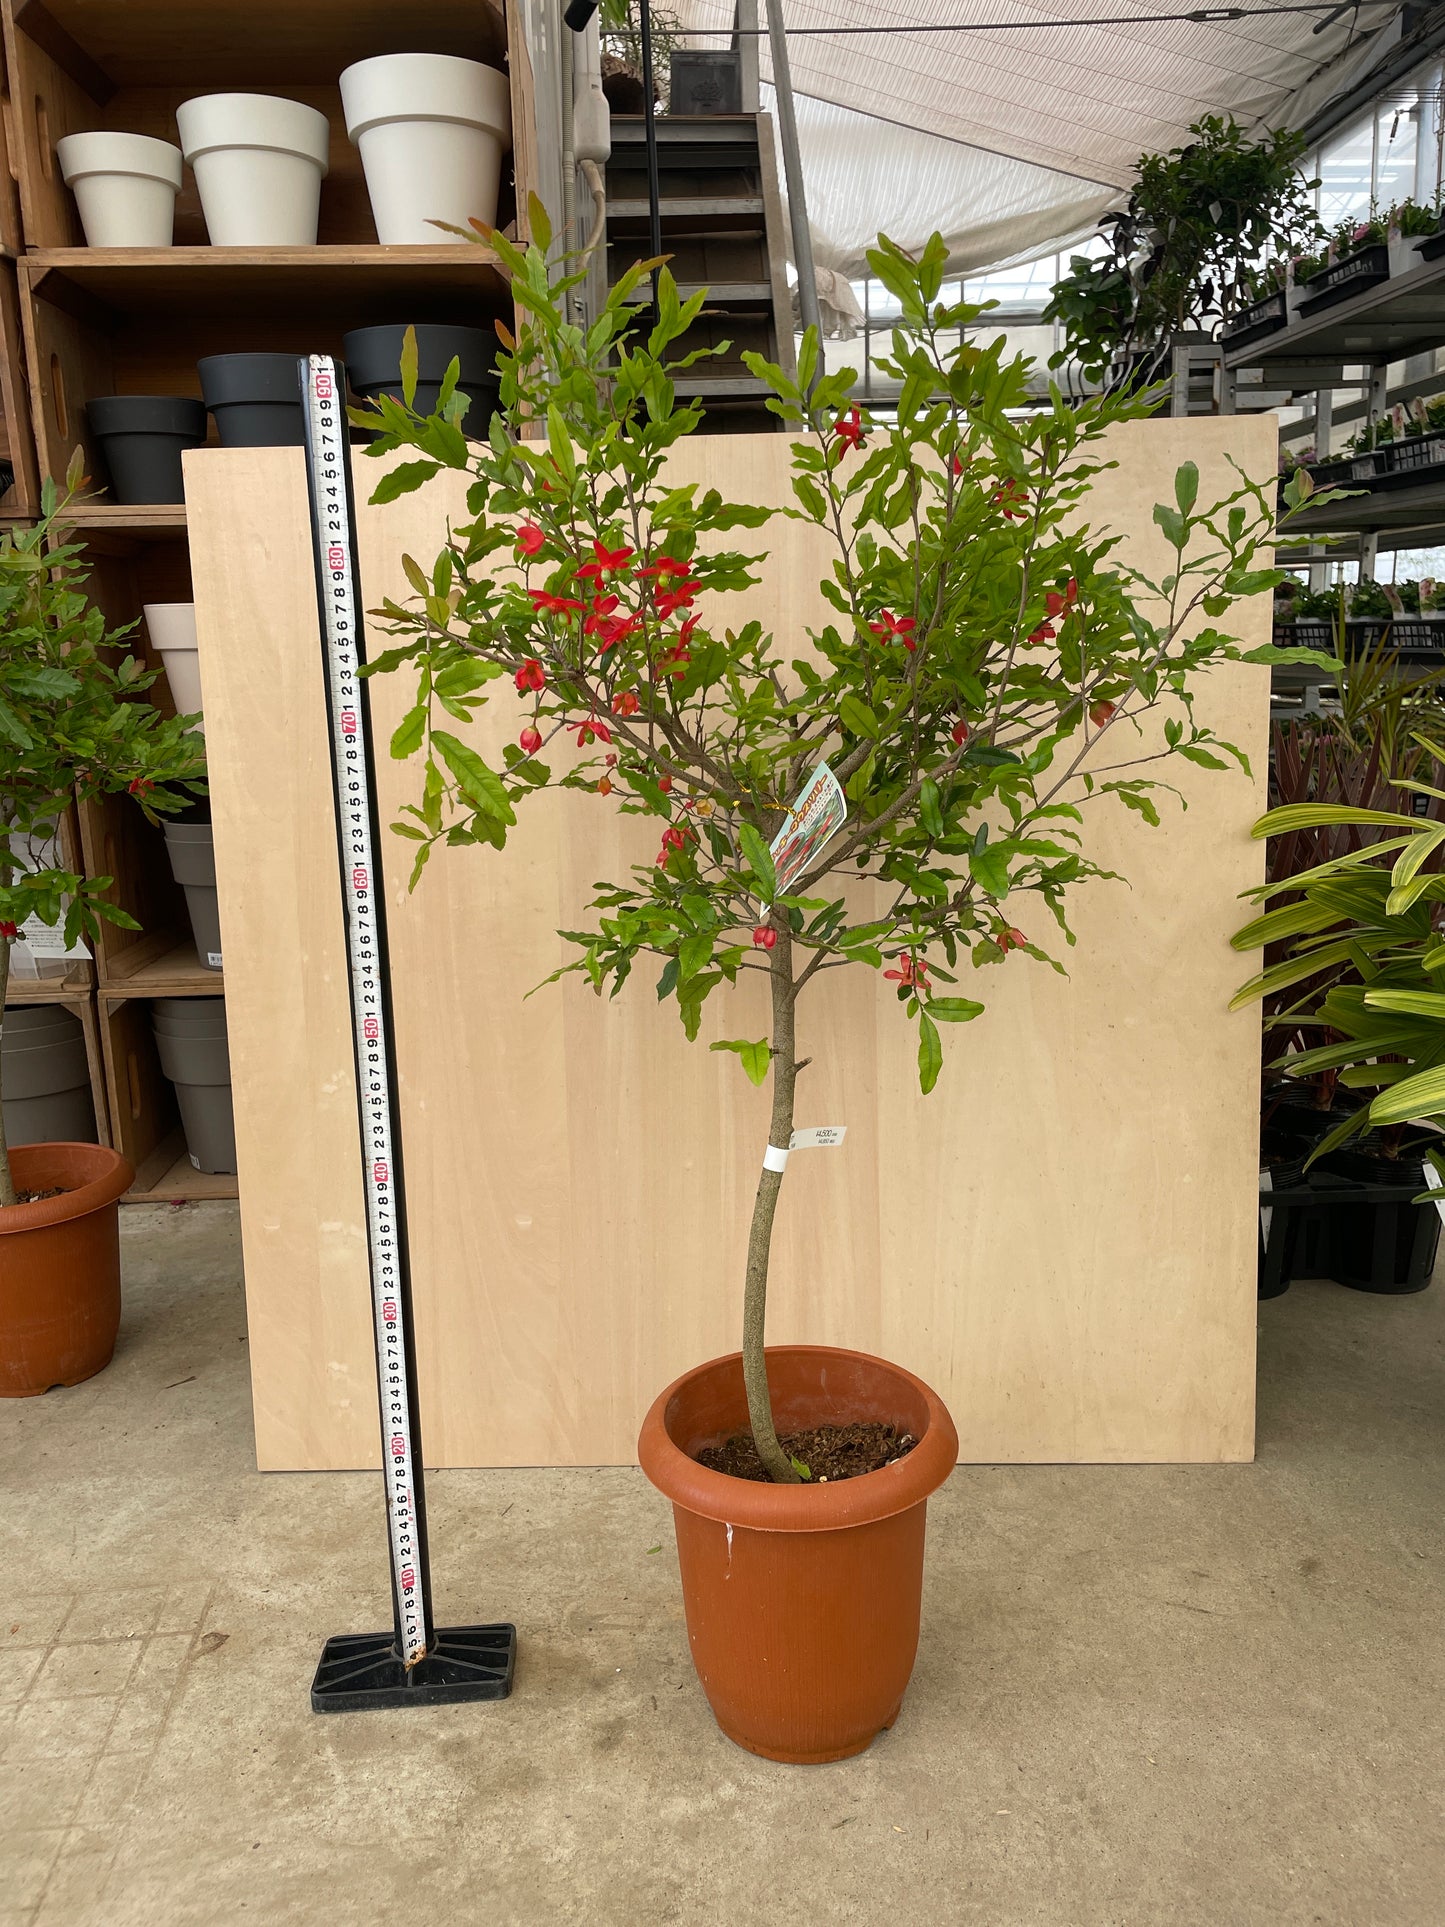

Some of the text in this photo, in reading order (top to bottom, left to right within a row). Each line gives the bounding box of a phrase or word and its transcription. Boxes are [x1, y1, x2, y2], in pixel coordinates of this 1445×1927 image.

[317, 377, 331, 395] 90
[320, 400, 331, 410] 9
[321, 417, 332, 427] 8
[322, 435, 334, 444] 7
[324, 452, 335, 462] 6
[325, 470, 336, 478] 5
[326, 486, 337, 496] 4
[327, 504, 339, 513] 3
[328, 521, 340, 530] 2
[330, 549, 344, 568] 80
[332, 571, 344, 581] 9
[334, 588, 345, 598] 8
[335, 604, 346, 614] 7
[336, 621, 348, 630] 6
[338, 638, 349, 646] 5
[339, 654, 350, 663] 4
[340, 670, 351, 680] 3
[341, 686, 352, 695] 2
[342, 714, 356, 730] 70
[345, 734, 356, 744] 9
[346, 750, 357, 760] 8
[347, 766, 358, 775] 7
[348, 782, 360, 791] 6
[350, 798, 360, 806] 5
[350, 813, 361, 822] 4
[352, 828, 363, 838] 3
[353, 844, 364, 853] 2
[354, 870, 368, 887] 60
[356, 890, 367, 899] 9
[358, 905, 368, 914] 8
[358, 920, 369, 929] 7
[360, 935, 370, 944] 6
[361, 950, 372, 959] 5
[362, 965, 372, 974] 4
[363, 980, 374, 989] 3
[364, 995, 374, 1003] 2
[364, 1020, 378, 1036] 50
[367, 1039, 378, 1048] 9
[368, 1054, 379, 1062] 8
[369, 1068, 380, 1077] 7
[370, 1082, 381, 1091] 6
[371, 1097, 382, 1105] 5
[372, 1112, 382, 1120] 4
[373, 1126, 384, 1134] 3
[374, 1140, 384, 1148] 2
[375, 1165, 388, 1180] 40
[377, 1182, 388, 1191] 9
[378, 1196, 388, 1205] 8
[379, 1211, 389, 1219] 7
[380, 1225, 390, 1233] 6
[382, 1252, 392, 1261] 4
[382, 1266, 393, 1274] 3
[384, 1303, 396, 1319] 30
[386, 1322, 396, 1330] 9
[387, 1335, 397, 1343] 8
[388, 1349, 398, 1357] 7
[388, 1362, 399, 1370] 6
[390, 1389, 400, 1397] 4
[391, 1402, 401, 1410] 3
[392, 1438, 405, 1454] 20
[394, 1456, 404, 1464] 9
[395, 1469, 406, 1477] 8
[397, 1495, 407, 1503] 6
[399, 1521, 409, 1529] 4
[400, 1534, 410, 1543] 3
[400, 1547, 411, 1556] 2
[402, 1570, 414, 1586] 10
[404, 1586, 414, 1596] 9
[405, 1599, 414, 1609] 8
[406, 1615, 415, 1623] 7
[407, 1626, 416, 1635] 6
[408, 1638, 417, 1648] 5
